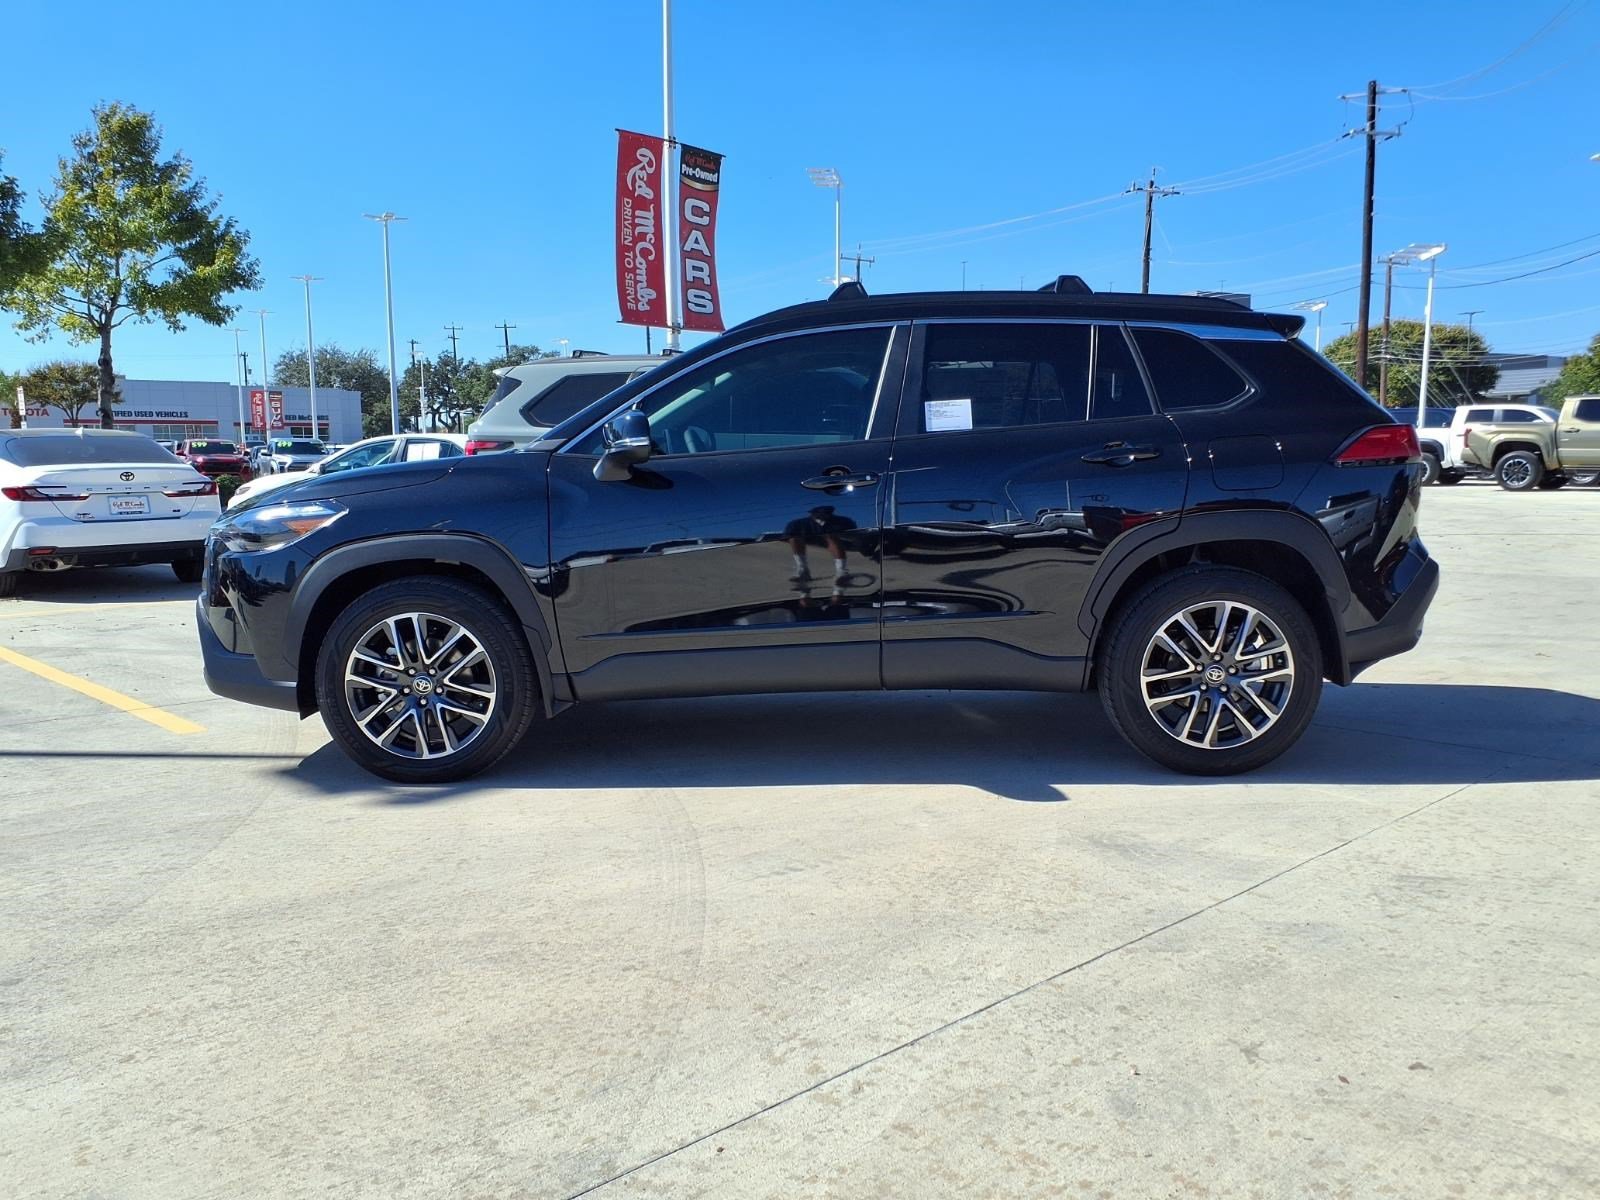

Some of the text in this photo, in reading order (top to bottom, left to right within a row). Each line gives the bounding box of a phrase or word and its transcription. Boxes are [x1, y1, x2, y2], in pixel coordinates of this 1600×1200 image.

[681, 164, 719, 183] Pre-Owned
[623, 197, 636, 311] DRIVEN TO SERVE
[626, 147, 656, 312] Red McCombs
[683, 198, 715, 314] CARS
[1, 407, 50, 417] TOTA
[95, 410, 133, 418] CTIFIED
[134, 410, 154, 418] USED
